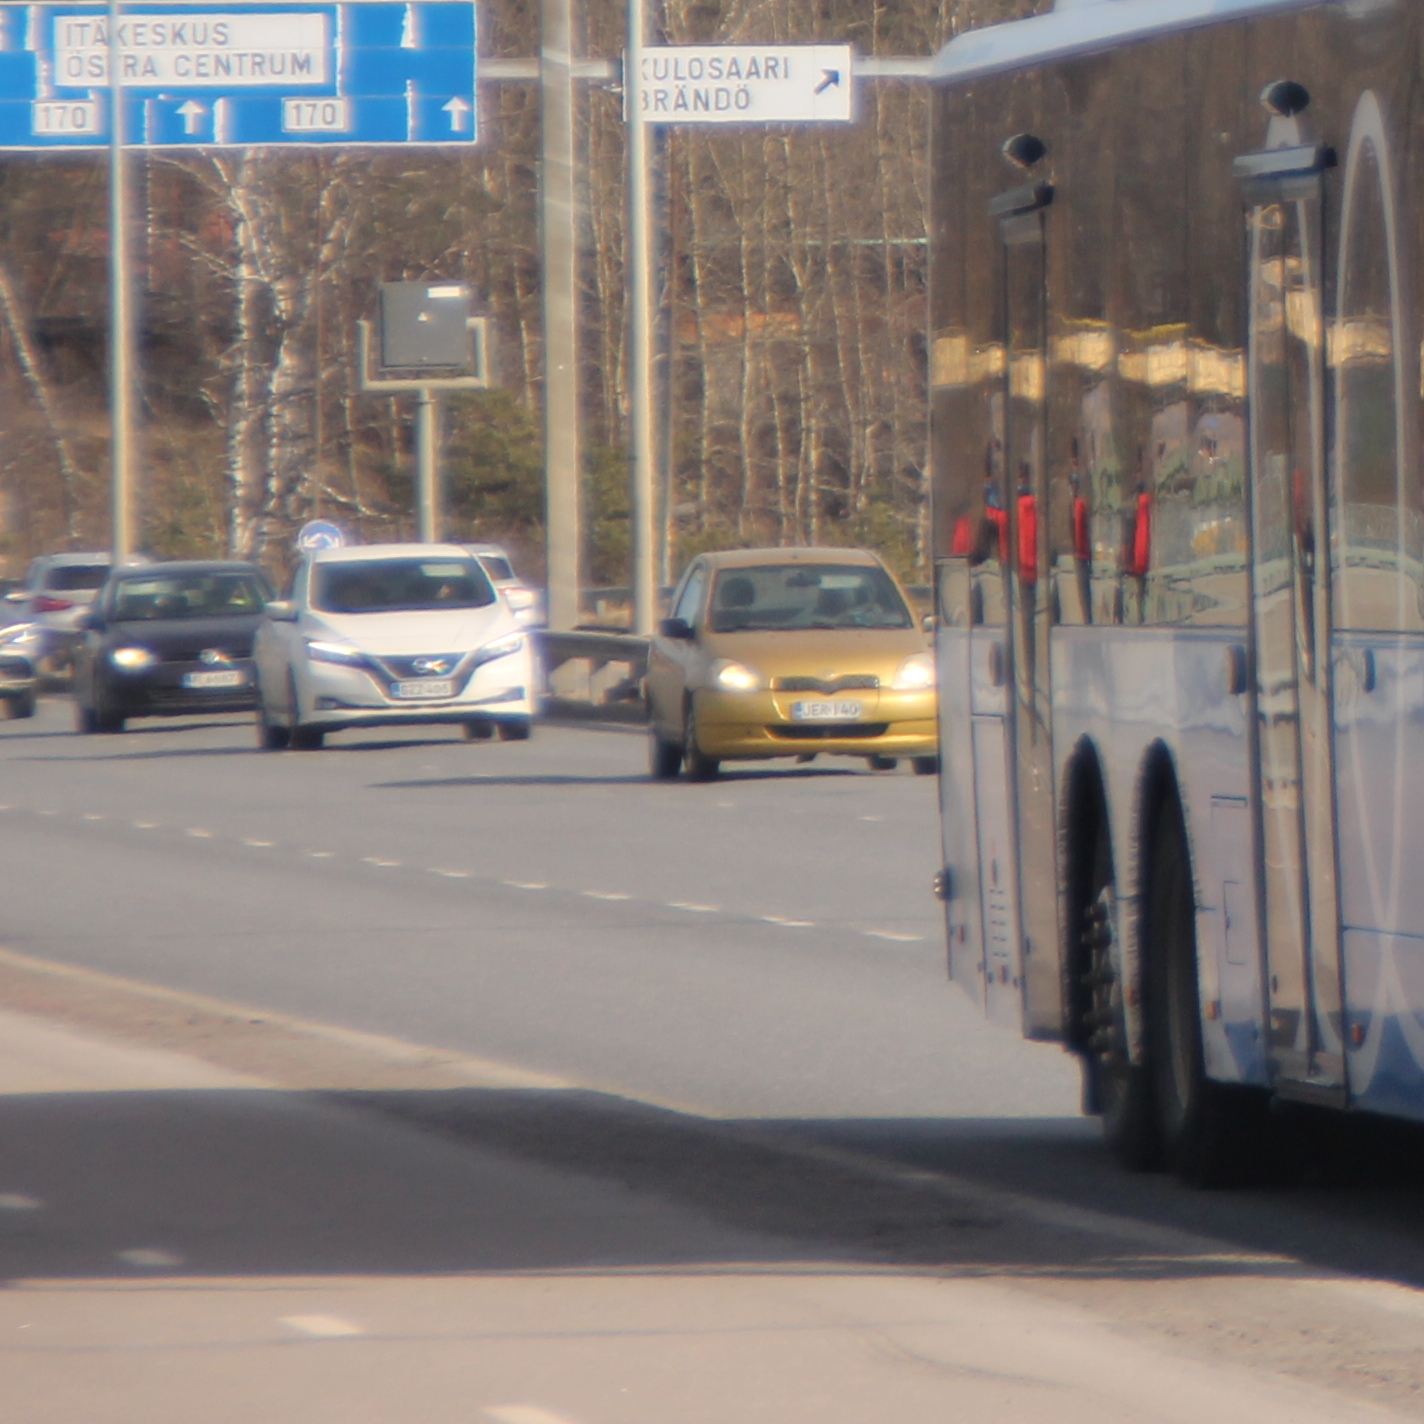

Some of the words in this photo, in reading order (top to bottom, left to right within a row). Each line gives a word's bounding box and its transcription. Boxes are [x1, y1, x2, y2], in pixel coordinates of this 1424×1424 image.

[65, 19, 228, 46] ITÄKESKUS
[67, 50, 158, 78] ÖSRA
[174, 53, 311, 77] CENTRUM
[43, 106, 86, 129] 170
[292, 103, 336, 125] 170
